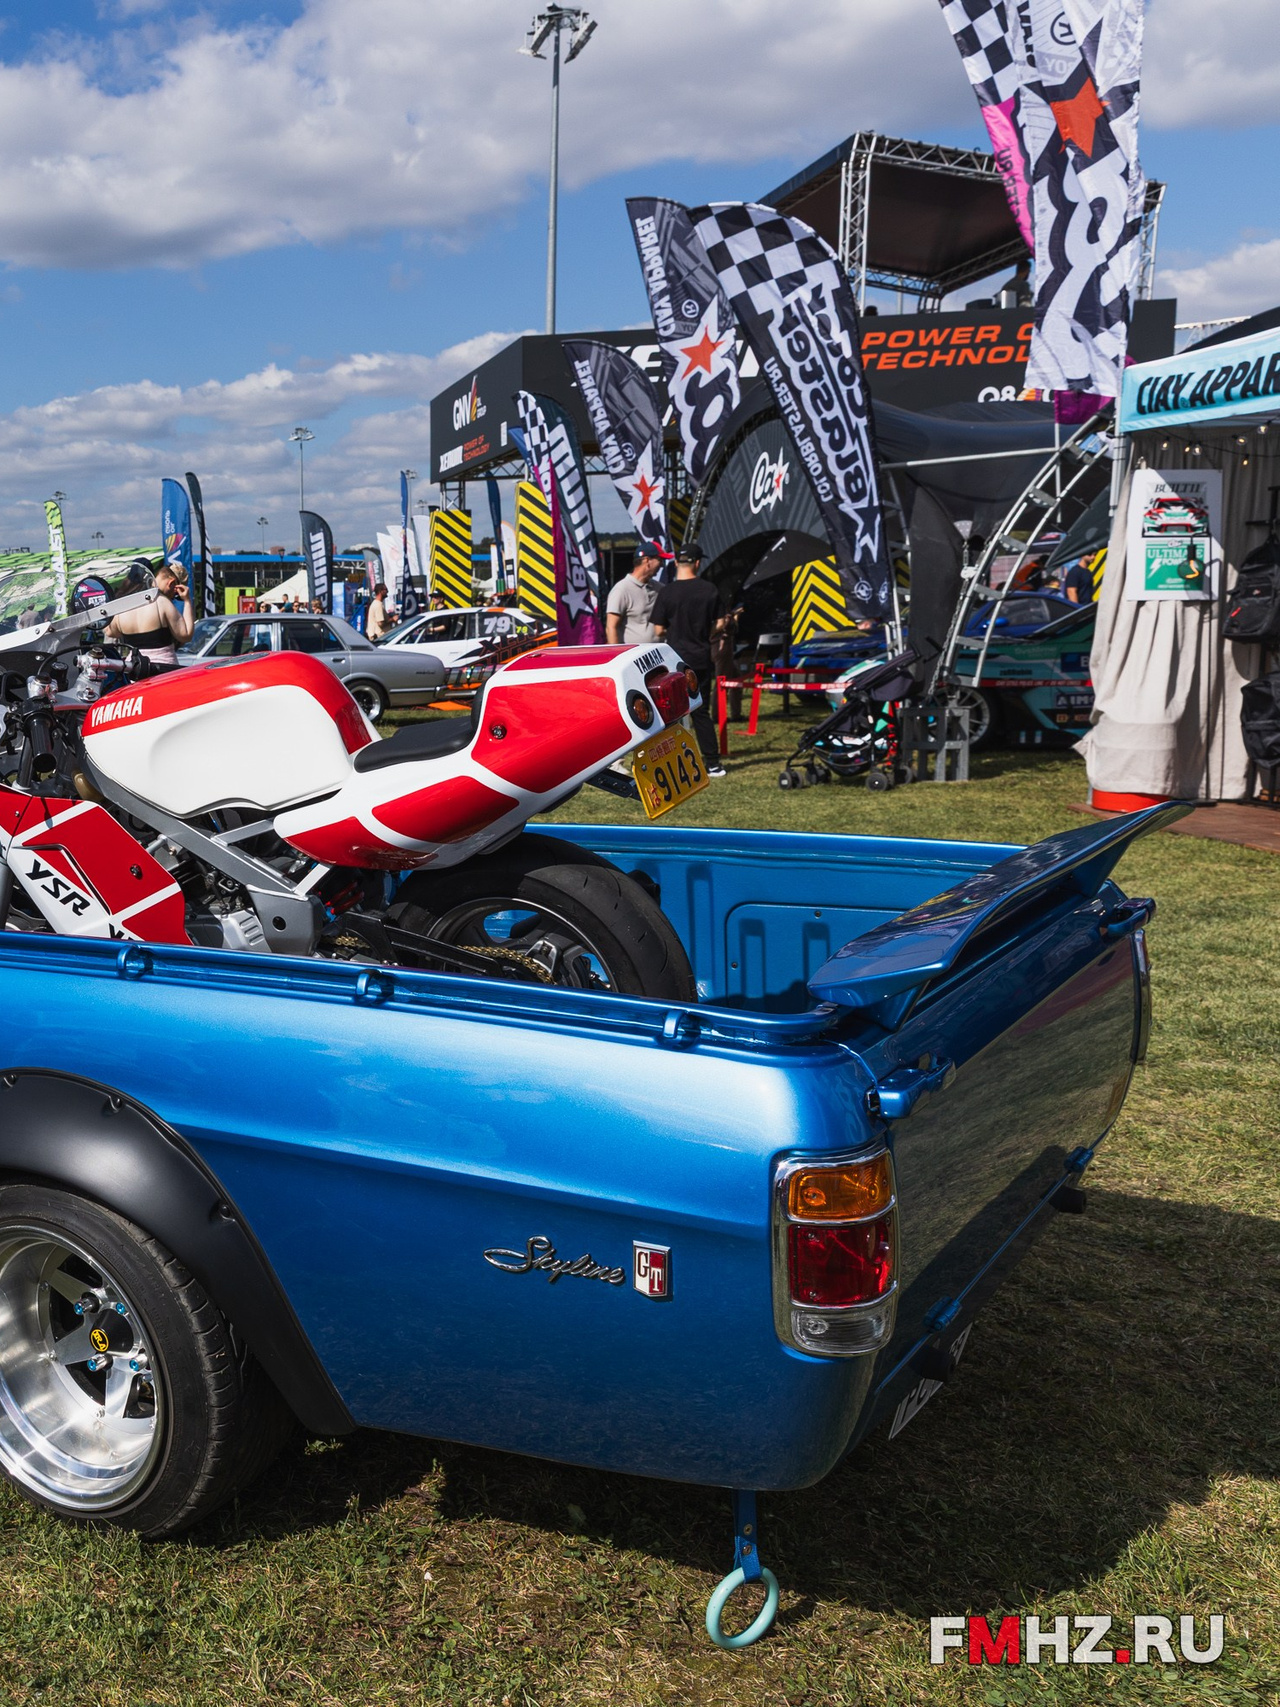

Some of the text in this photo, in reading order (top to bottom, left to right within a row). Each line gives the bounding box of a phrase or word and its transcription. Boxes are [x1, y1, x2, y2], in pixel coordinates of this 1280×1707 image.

[861, 322, 1034, 350] POWER O
[453, 391, 471, 431] GNV
[1137, 372, 1195, 415] CIAY
[1146, 548, 1203, 559] ULTIMAE
[483, 616, 511, 634] 79
[633, 648, 665, 674] YAMAHA
[91, 696, 144, 728] YAMAHA
[654, 748, 701, 802] 9143
[25, 859, 91, 917] YSR
[483, 1234, 663, 1292] Skyline GT
